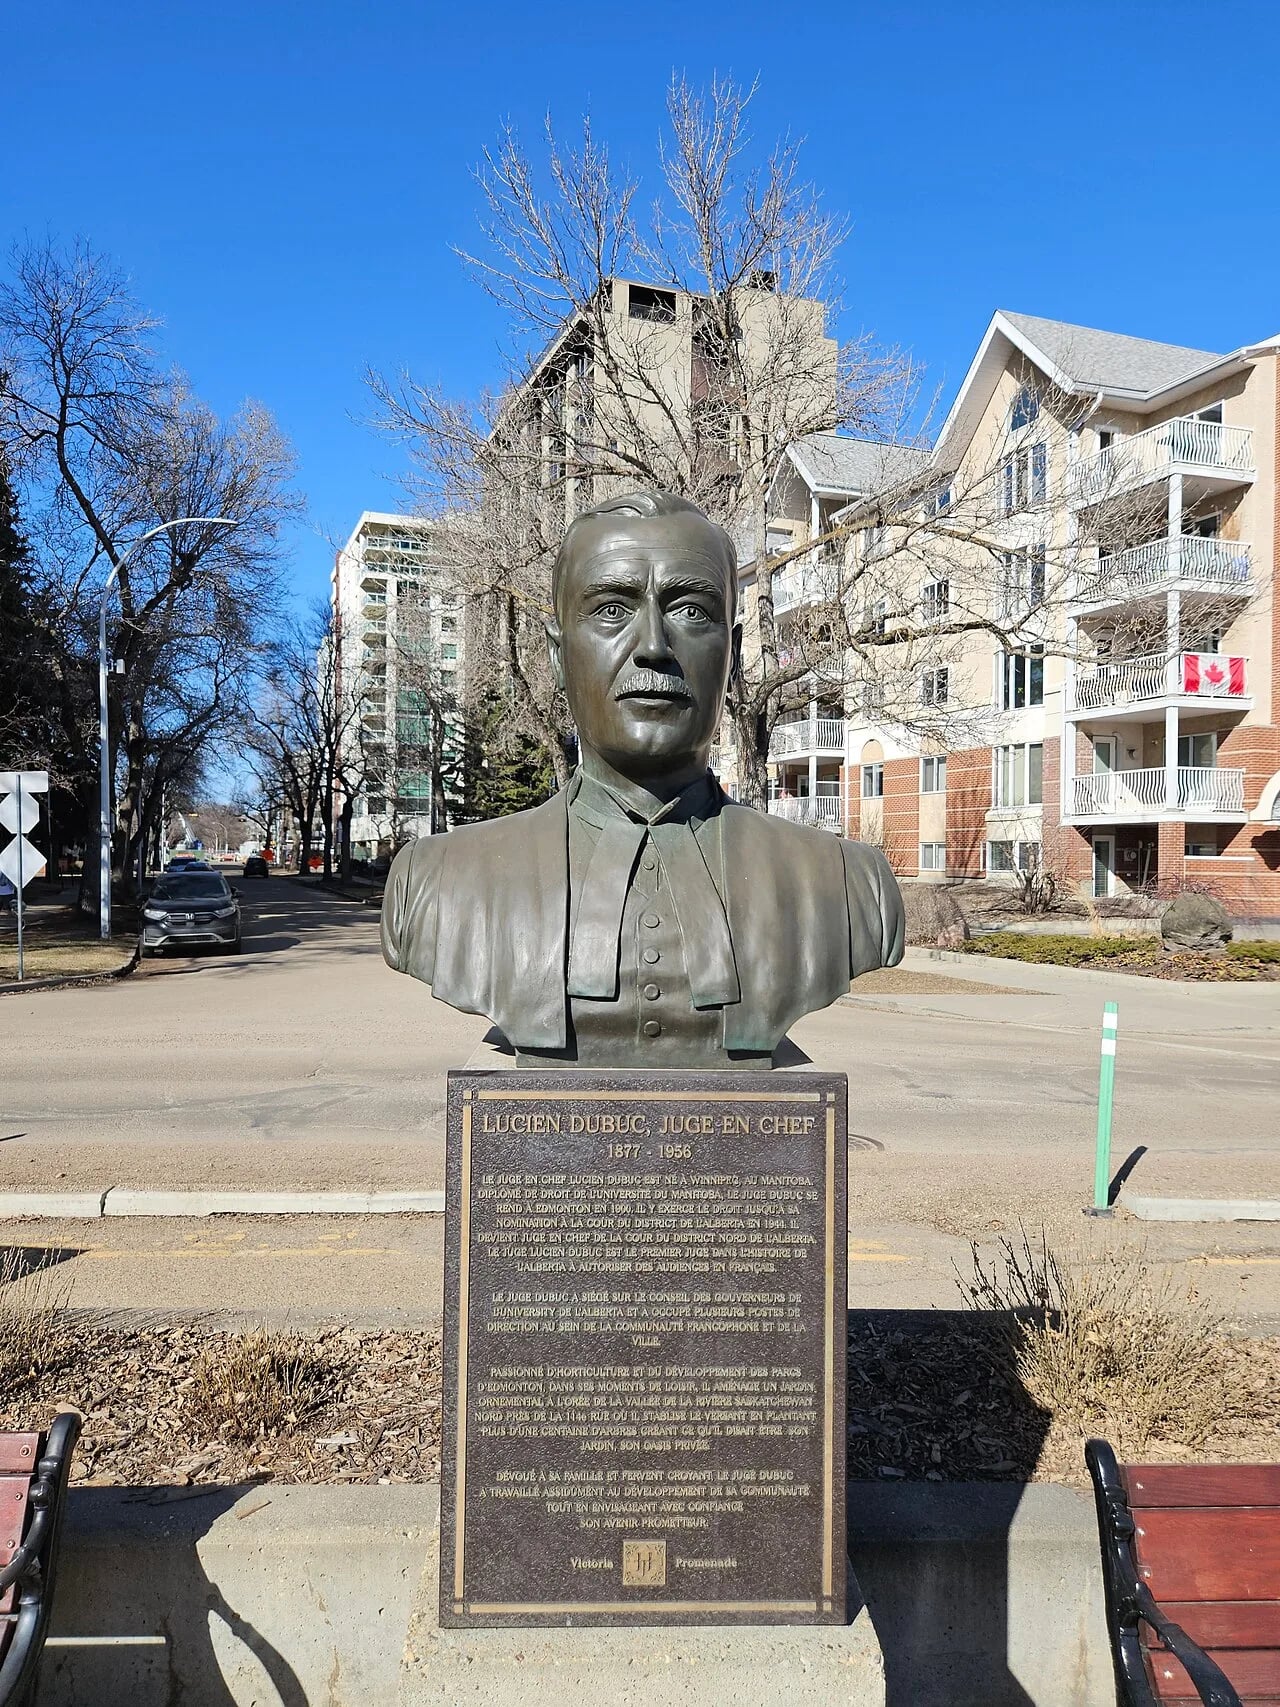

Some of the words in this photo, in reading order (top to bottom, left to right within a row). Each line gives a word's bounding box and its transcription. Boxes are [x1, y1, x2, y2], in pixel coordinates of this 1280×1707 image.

[481, 1114, 562, 1133] LUCIEN
[568, 1114, 653, 1137] DUBUC,
[659, 1115, 716, 1134] JUGE
[721, 1115, 752, 1134] EN
[758, 1116, 816, 1135] CHEF
[609, 1143, 642, 1158] 1877
[659, 1143, 693, 1159] 1956
[482, 1174, 495, 1185] LE
[498, 1174, 521, 1185] JUGE
[525, 1174, 538, 1185] EN
[540, 1174, 567, 1185] CHEF
[569, 1174, 605, 1185] LUCIEN
[608, 1174, 642, 1185] DUBUC
[644, 1174, 662, 1185] EST
[745, 1174, 759, 1185] AU
[525, 1189, 538, 1199] DE
[540, 1189, 571, 1199] DROIT
[573, 1189, 586, 1199] DE
[654, 1189, 669, 1199] DU
[727, 1189, 740, 1199] LE
[742, 1189, 767, 1199] JUGE
[769, 1189, 803, 1199] DUBUC
[806, 1189, 819, 1199] SE
[496, 1203, 524, 1213] REND
[535, 1203, 592, 1213] EDMONTON
[594, 1203, 608, 1213] EN
[648, 1203, 657, 1213] Y
[658, 1203, 695, 1213] EXERCE
[696, 1203, 710, 1213] LE
[712, 1203, 744, 1213] DROIT
[788, 1203, 802, 1213] SA
[496, 1217, 558, 1228] NOMINATION
[571, 1217, 584, 1228] LA
[586, 1217, 614, 1228] COUR
[616, 1217, 631, 1228] DU
[634, 1217, 678, 1228] DISTRICT
[680, 1217, 693, 1228] DE
[747, 1217, 762, 1228] EN
[522, 1233, 546, 1243] JUGE
[549, 1233, 563, 1243] EN
[565, 1233, 591, 1243] CHEF
[594, 1233, 607, 1243] DE
[609, 1233, 623, 1243] LA
[625, 1233, 654, 1243] COUR
[656, 1233, 671, 1243] DU
[673, 1233, 717, 1243] DISTRICT
[720, 1233, 748, 1243] NORD
[750, 1233, 764, 1243] DE
[488, 1247, 501, 1258] LE
[503, 1247, 529, 1258] JUGE
[530, 1247, 566, 1258] LUCIEN
[568, 1247, 603, 1258] DUBUC
[605, 1247, 623, 1258] EST
[625, 1247, 638, 1258] LE
[641, 1247, 683, 1258] PREMIER
[685, 1247, 710, 1258] JUGE
[712, 1247, 738, 1258] DANS
[794, 1247, 808, 1258] DE
[580, 1262, 633, 1272] AUTORISER
[635, 1262, 654, 1272] DES
[655, 1262, 711, 1272] AUDIENCES
[713, 1262, 727, 1272] EN
[569, 1557, 615, 1569] Victoria
[675, 1557, 738, 1569] Promenade
